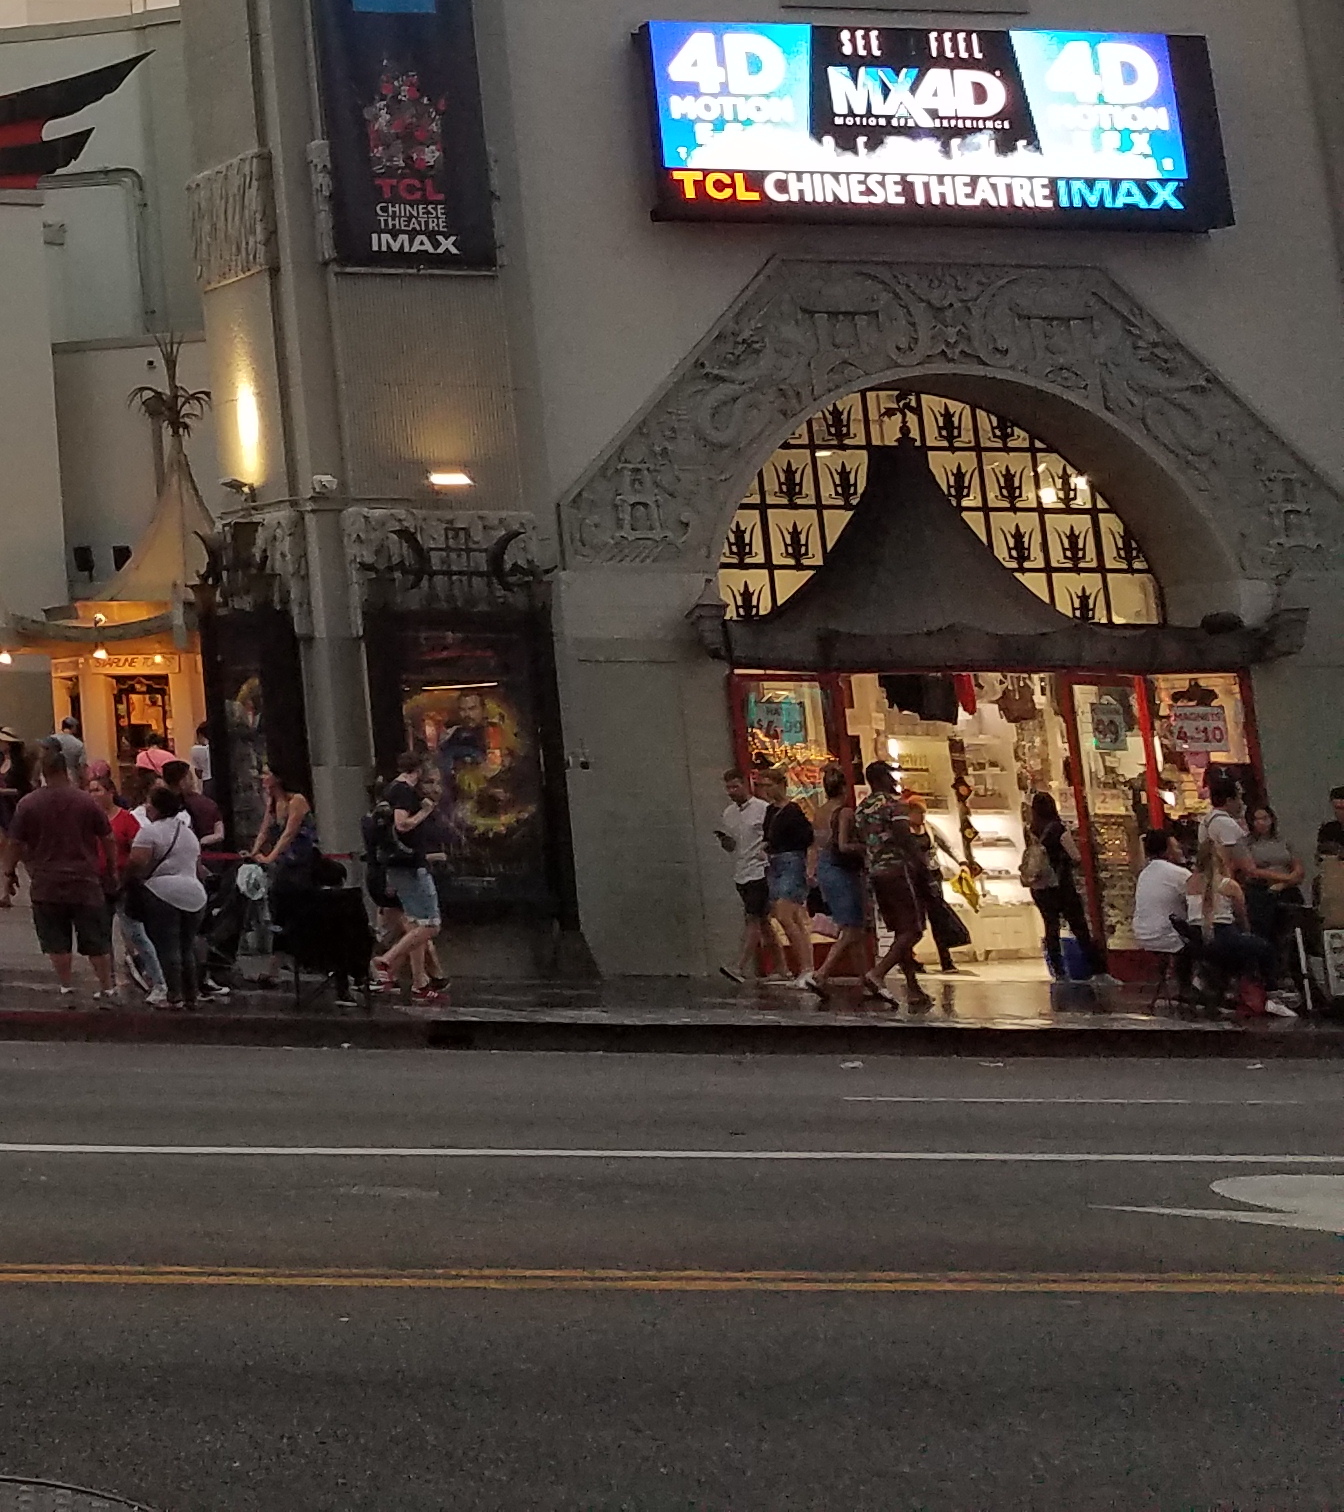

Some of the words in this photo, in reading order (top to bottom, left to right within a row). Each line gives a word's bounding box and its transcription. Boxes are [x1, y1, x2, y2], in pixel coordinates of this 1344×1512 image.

[840, 29, 882, 57] SEE
[929, 31, 983, 59] FEEL
[668, 32, 785, 94] 4D
[1045, 41, 1159, 104] 4D
[670, 95, 794, 124] MOTION
[827, 66, 1007, 127] MX4D
[834, 116, 887, 127] MOTION
[374, 178, 446, 201] TCL
[672, 171, 761, 201] TCL
[764, 172, 906, 205] CHINESE
[907, 174, 1054, 208] THEATRE
[1056, 179, 1185, 210] IMAX
[375, 203, 447, 218] CHINESE
[377, 216, 448, 232] THEATRE
[371, 233, 460, 255] IMAX
